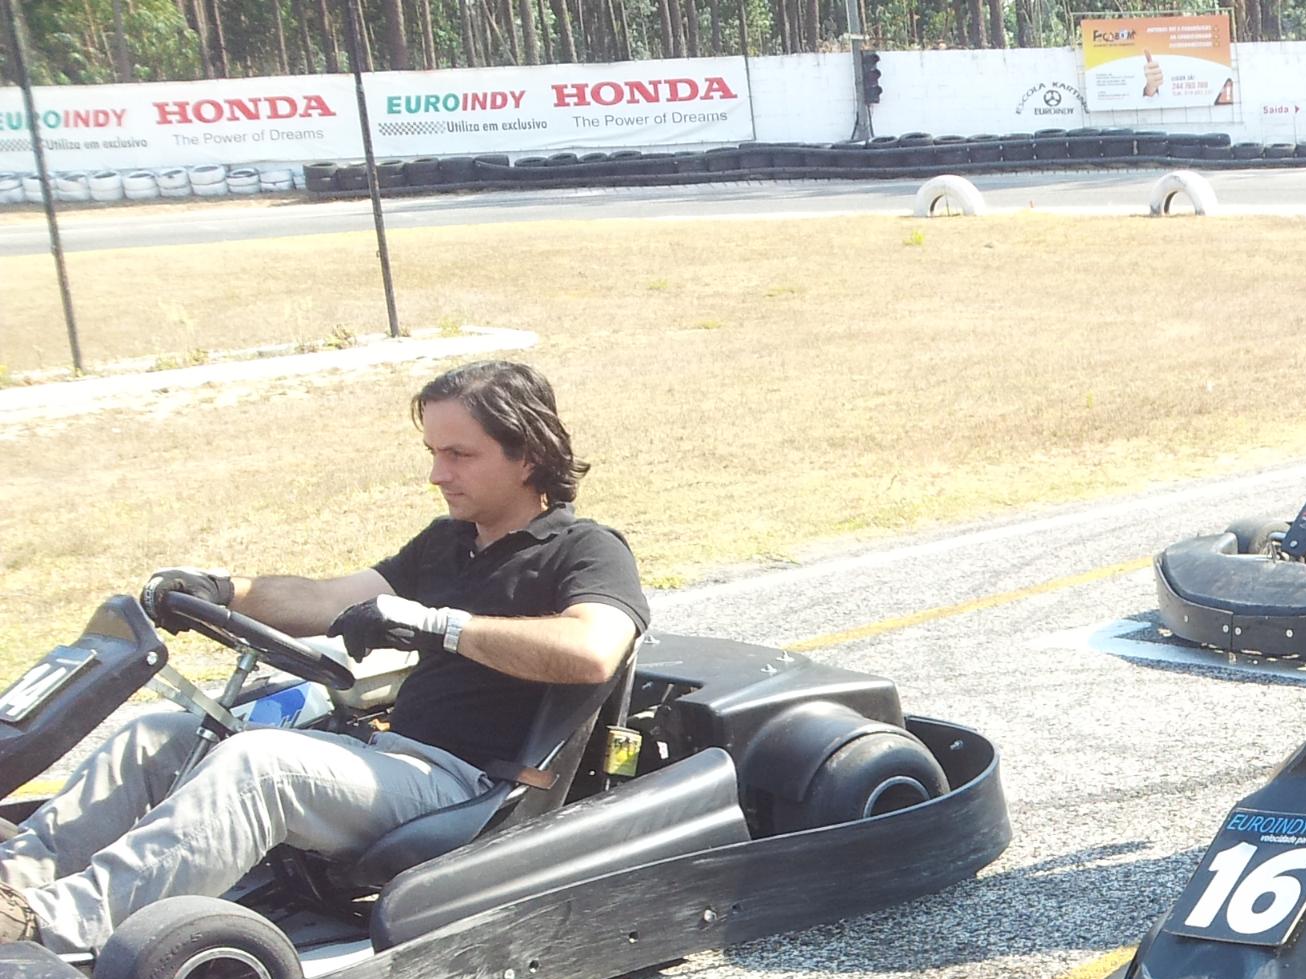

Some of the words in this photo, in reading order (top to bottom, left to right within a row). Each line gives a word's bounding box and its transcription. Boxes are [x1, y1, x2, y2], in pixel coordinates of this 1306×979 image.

[386, 90, 526, 114] EUROINDY
[551, 76, 738, 108] HONDA
[151, 94, 337, 125] HONDA
[572, 115, 600, 129] The
[604, 113, 650, 127] Power
[654, 112, 668, 125] of
[672, 110, 728, 124] Dreams
[0, 109, 127, 131] UOINDY
[446, 120, 480, 133] Utiliza
[482, 123, 499, 132] em
[501, 119, 548, 132] exclusivo
[45, 138, 81, 150] Utiliza
[84, 140, 100, 149] em
[102, 137, 149, 149] exclusivo
[172, 133, 199, 146] The
[203, 132, 247, 145] Power
[251, 130, 267, 143] of
[269, 127, 325, 143] Dreams
